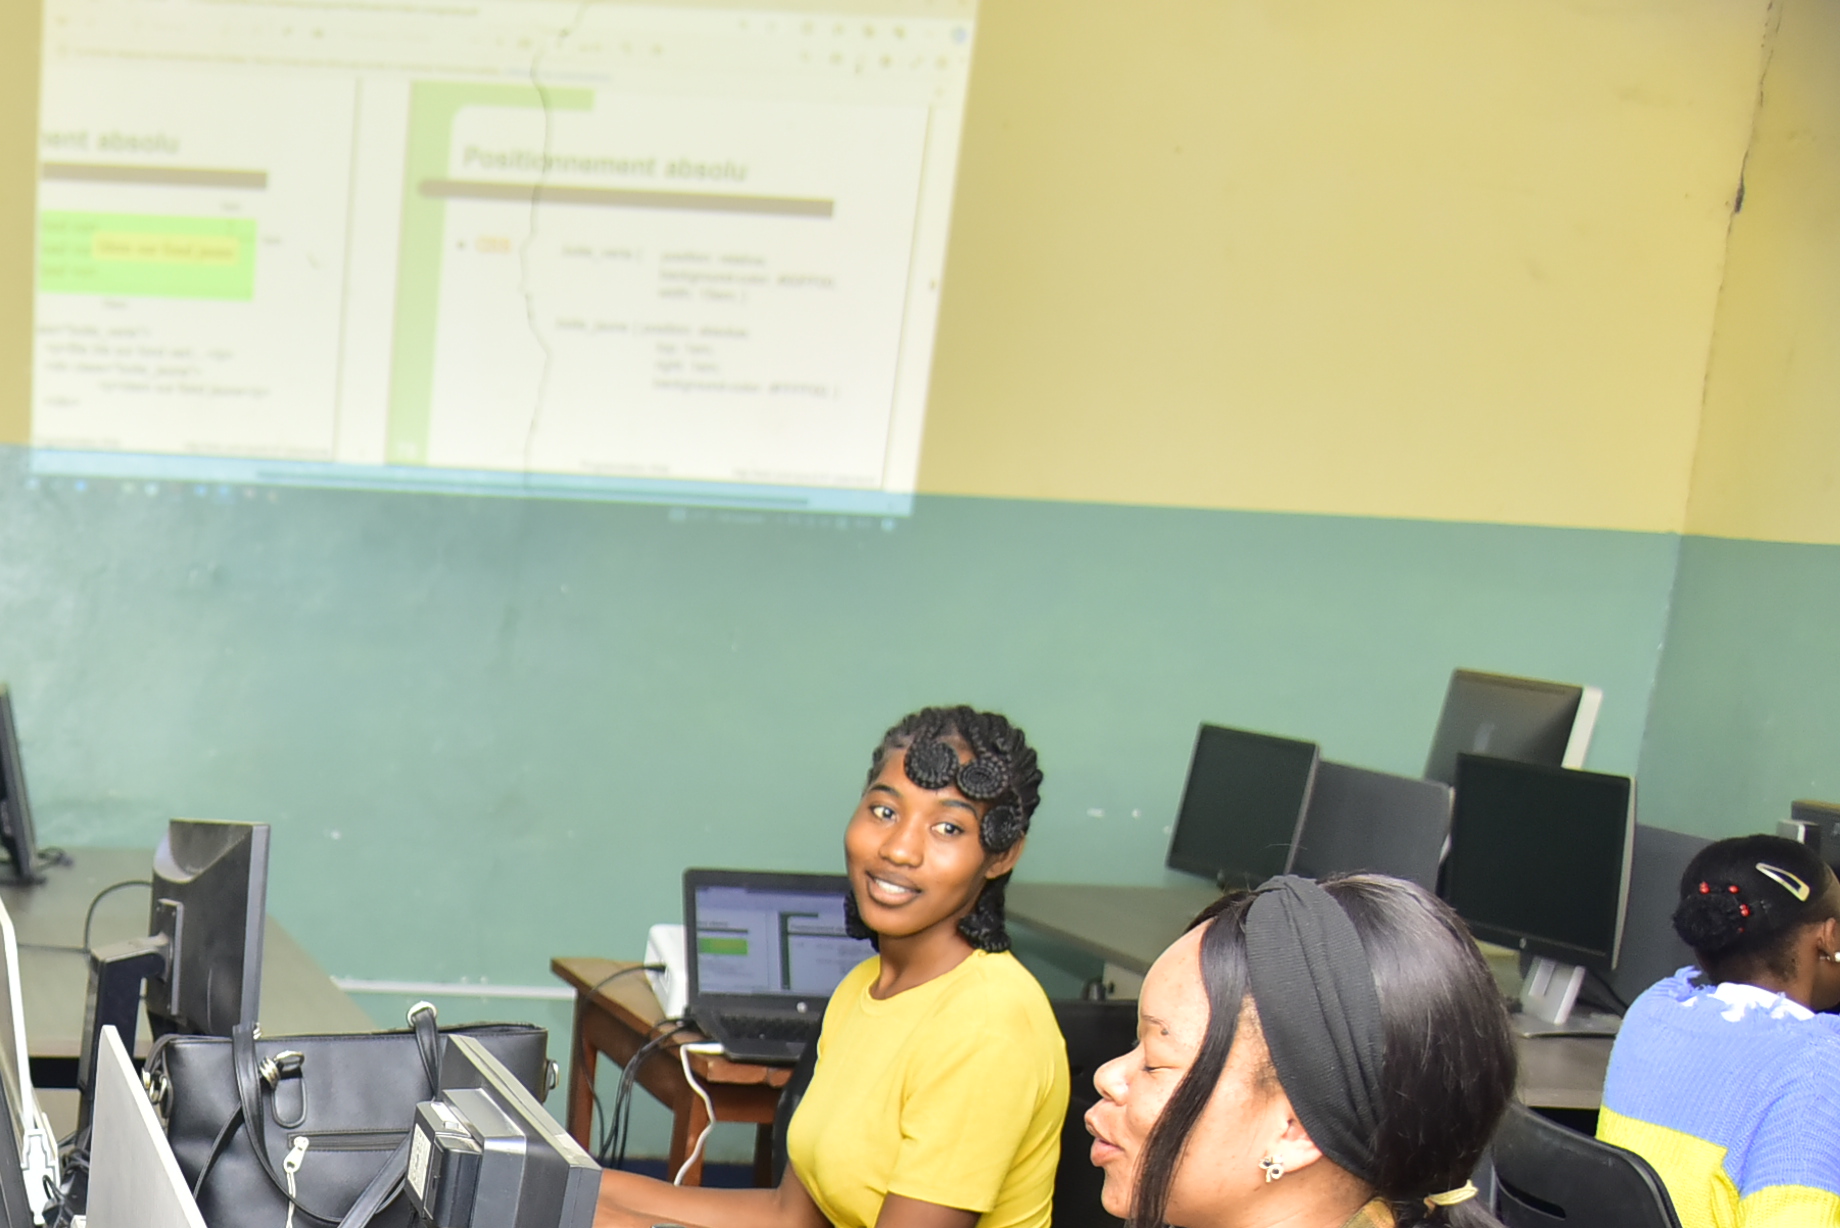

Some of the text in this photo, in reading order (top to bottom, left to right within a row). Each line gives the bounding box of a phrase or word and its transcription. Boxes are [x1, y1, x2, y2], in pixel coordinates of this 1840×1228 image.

[97, 130, 181, 154] absolu
[462, 144, 748, 182] Positionnement absolu
